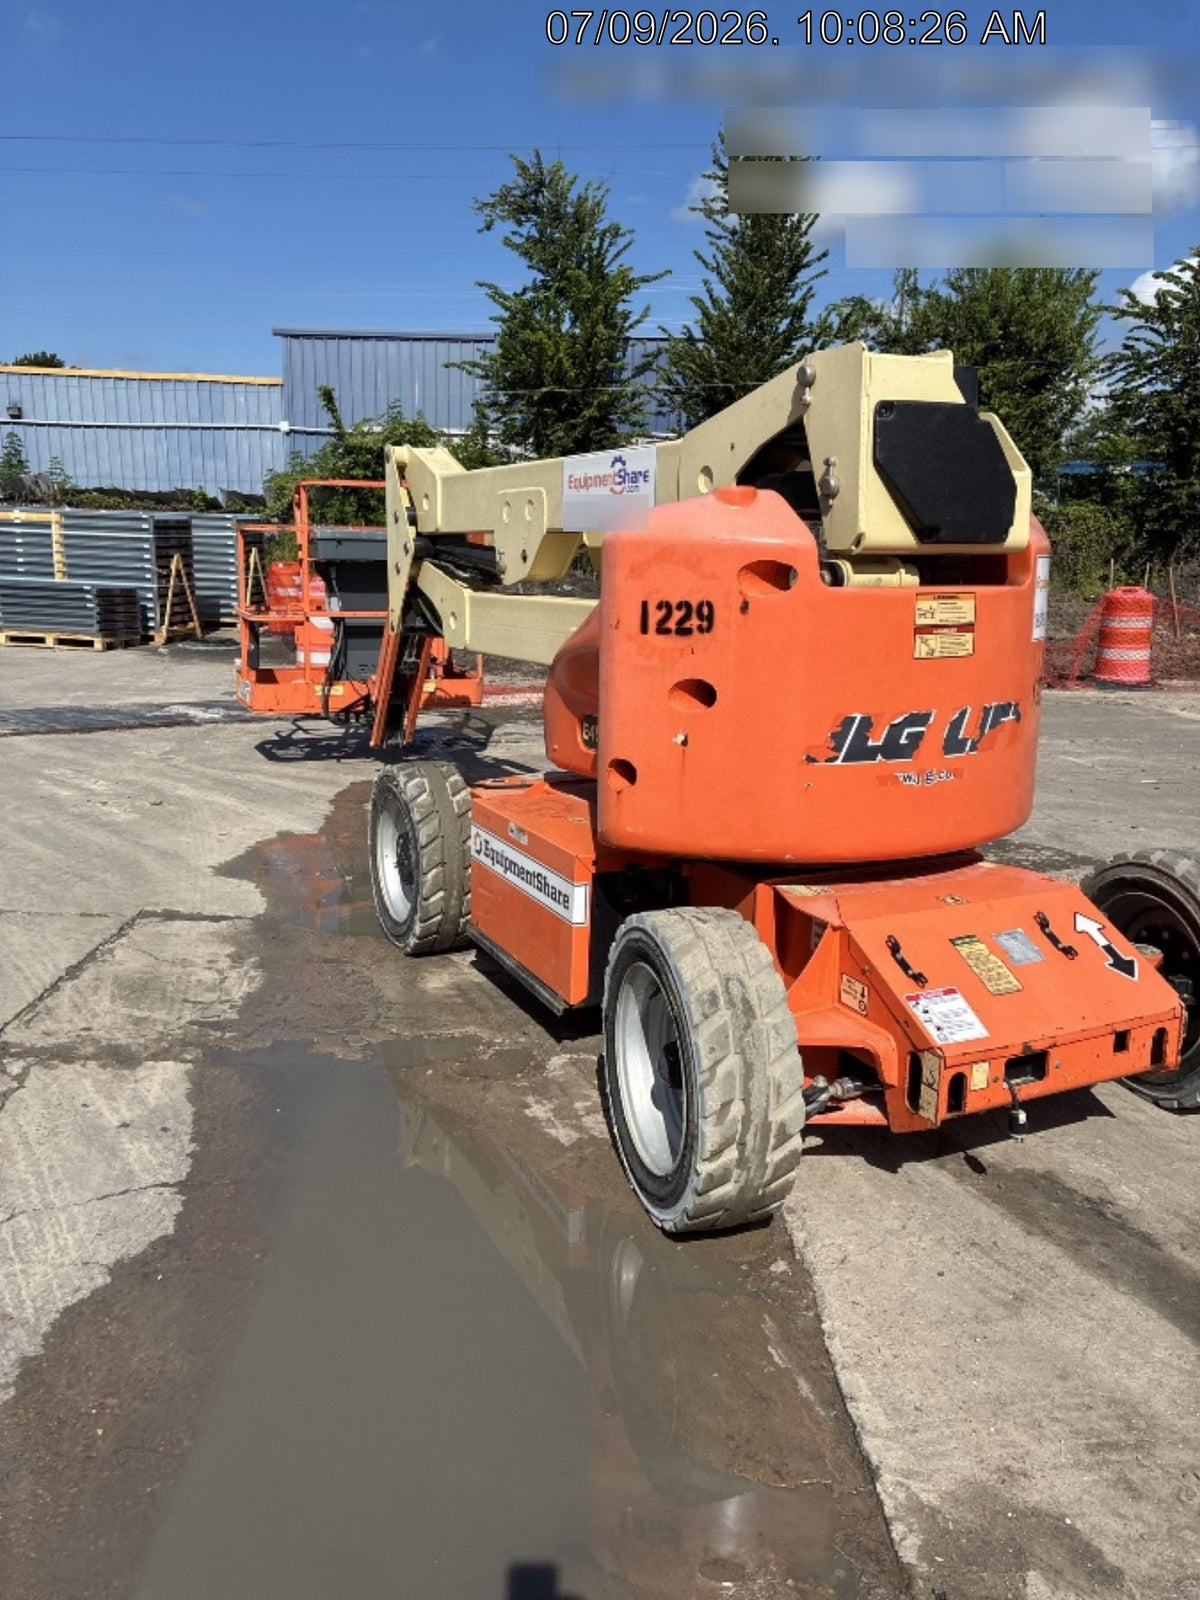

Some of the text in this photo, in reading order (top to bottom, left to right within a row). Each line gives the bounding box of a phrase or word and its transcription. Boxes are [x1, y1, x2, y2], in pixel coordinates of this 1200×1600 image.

[568, 467, 650, 492] EquipmentShare
[640, 600, 715, 636] 1229
[483, 838, 570, 910] EquipmentShare
